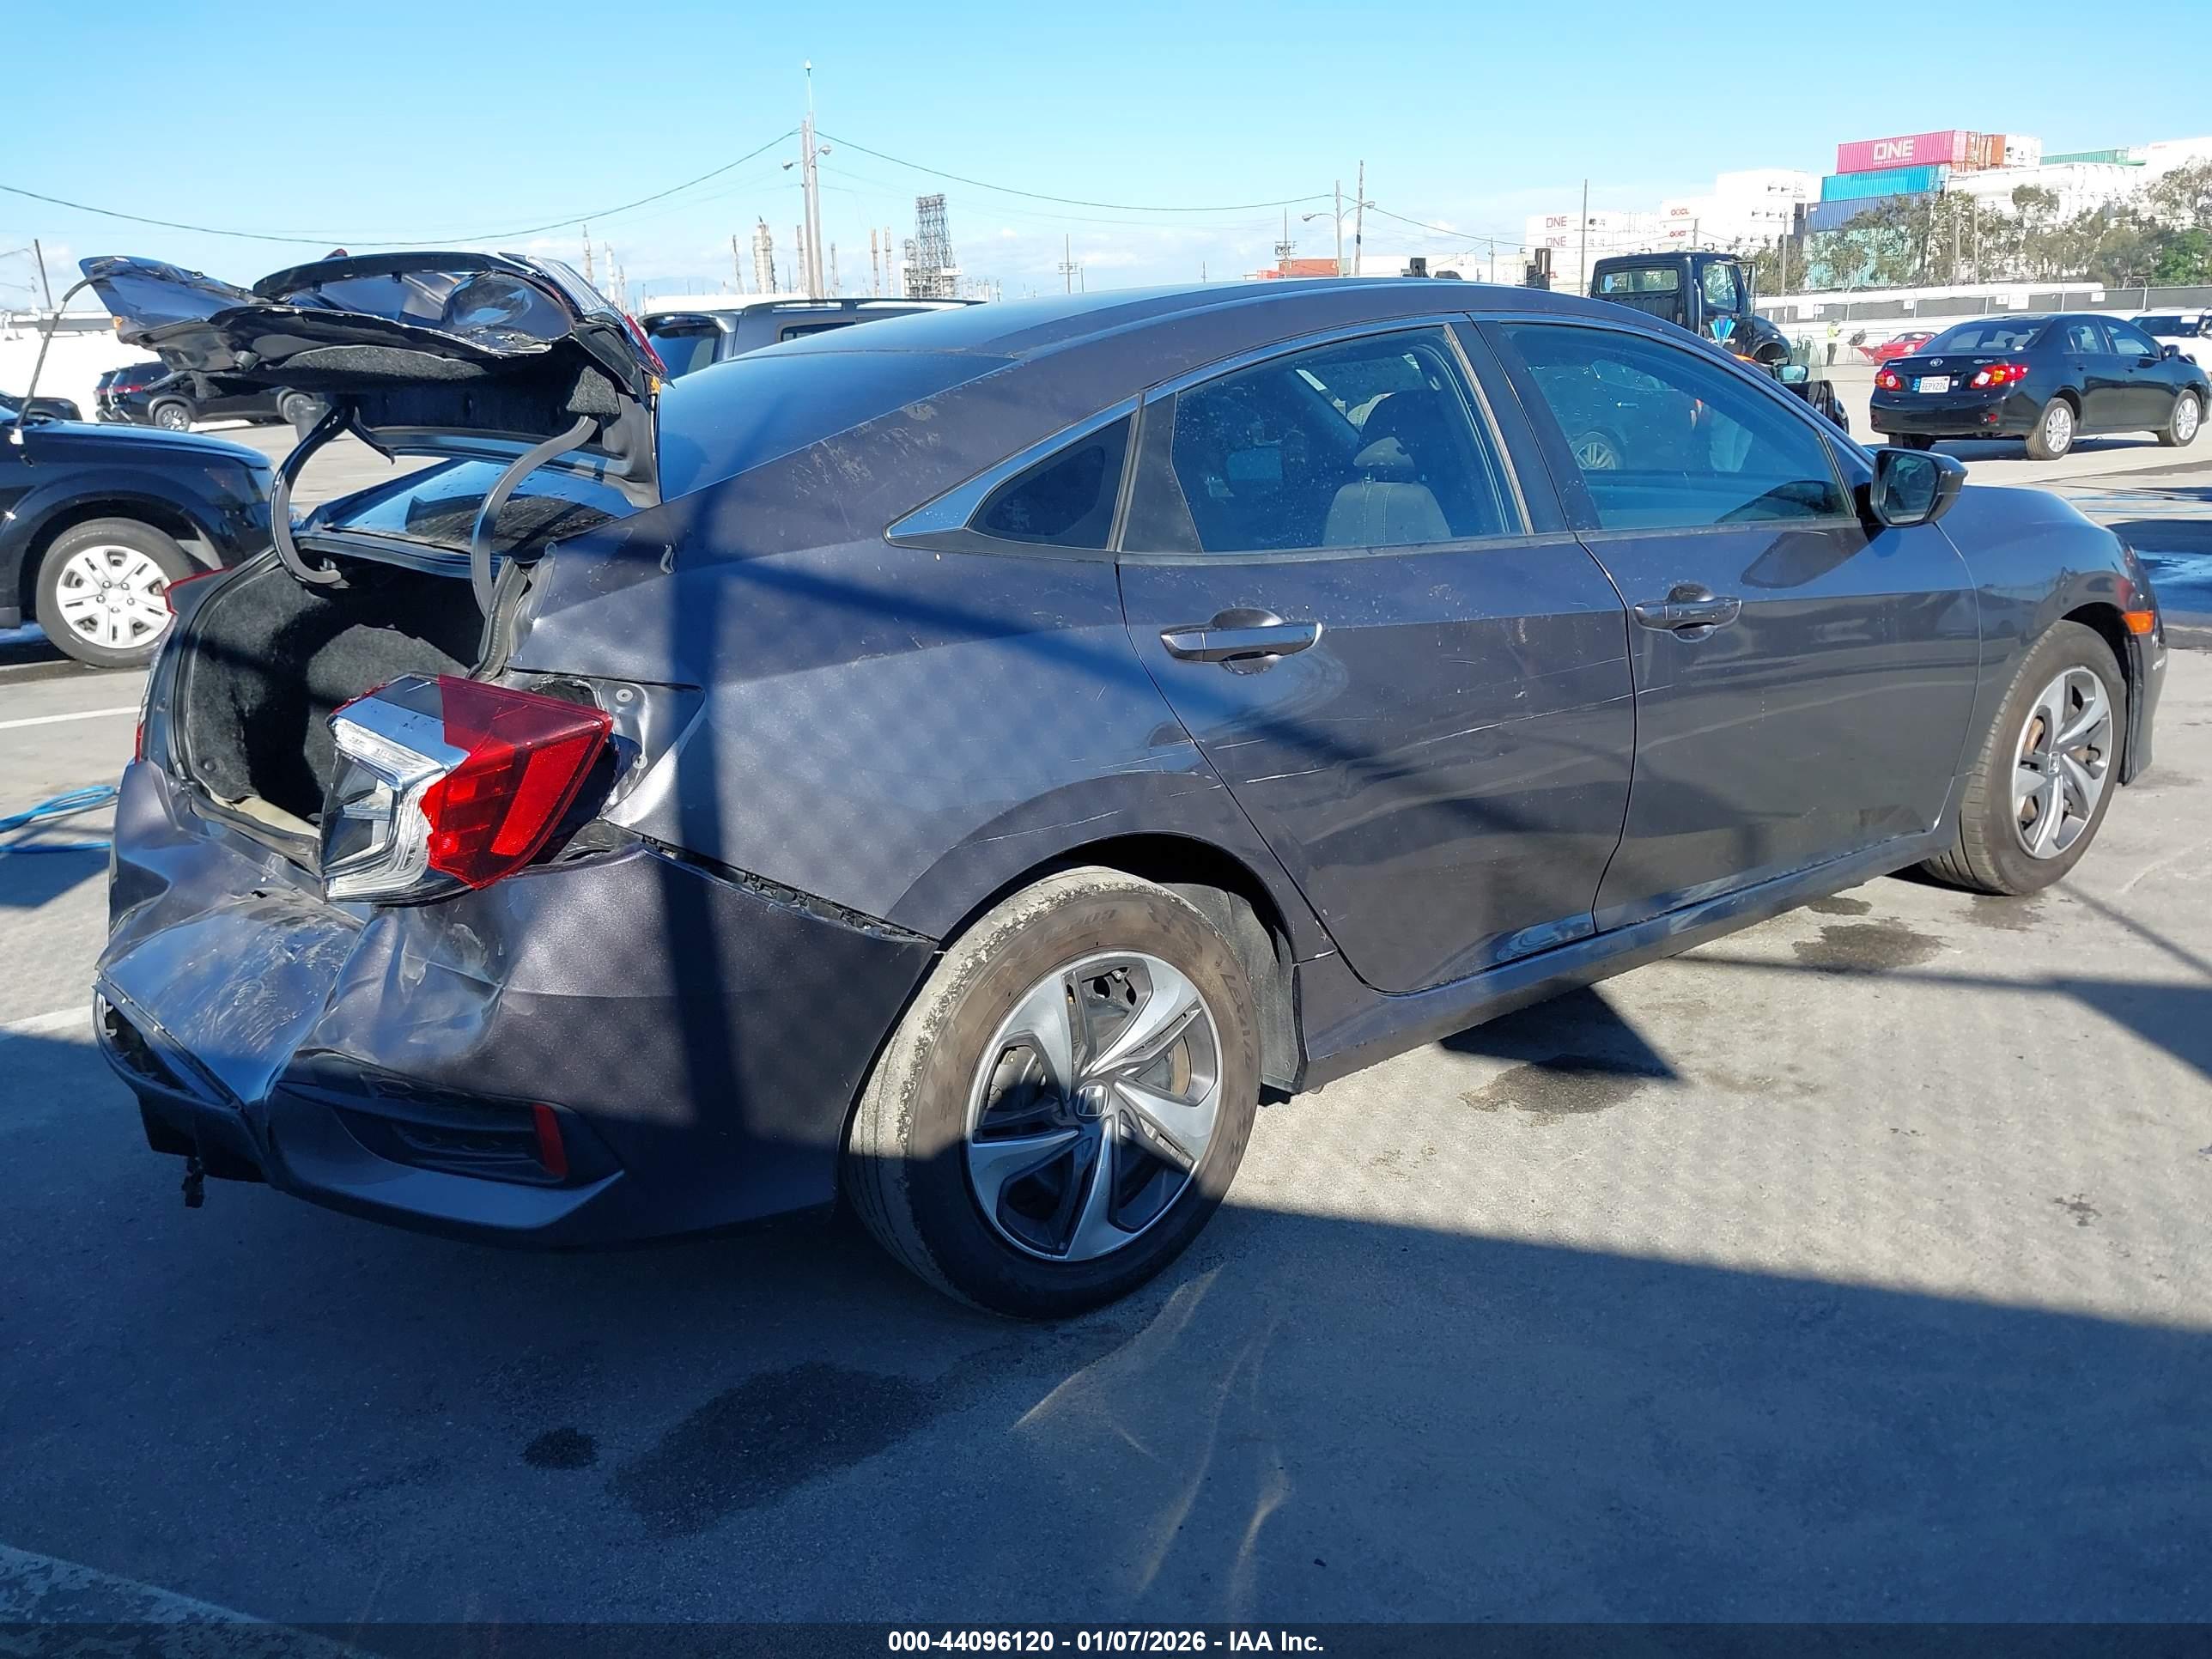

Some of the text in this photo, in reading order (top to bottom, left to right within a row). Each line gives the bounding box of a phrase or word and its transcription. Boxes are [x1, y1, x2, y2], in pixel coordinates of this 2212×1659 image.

[1873, 140, 1915, 160] ONE
[1546, 216, 1567, 228] ONE
[1546, 236, 1567, 247] ONE
